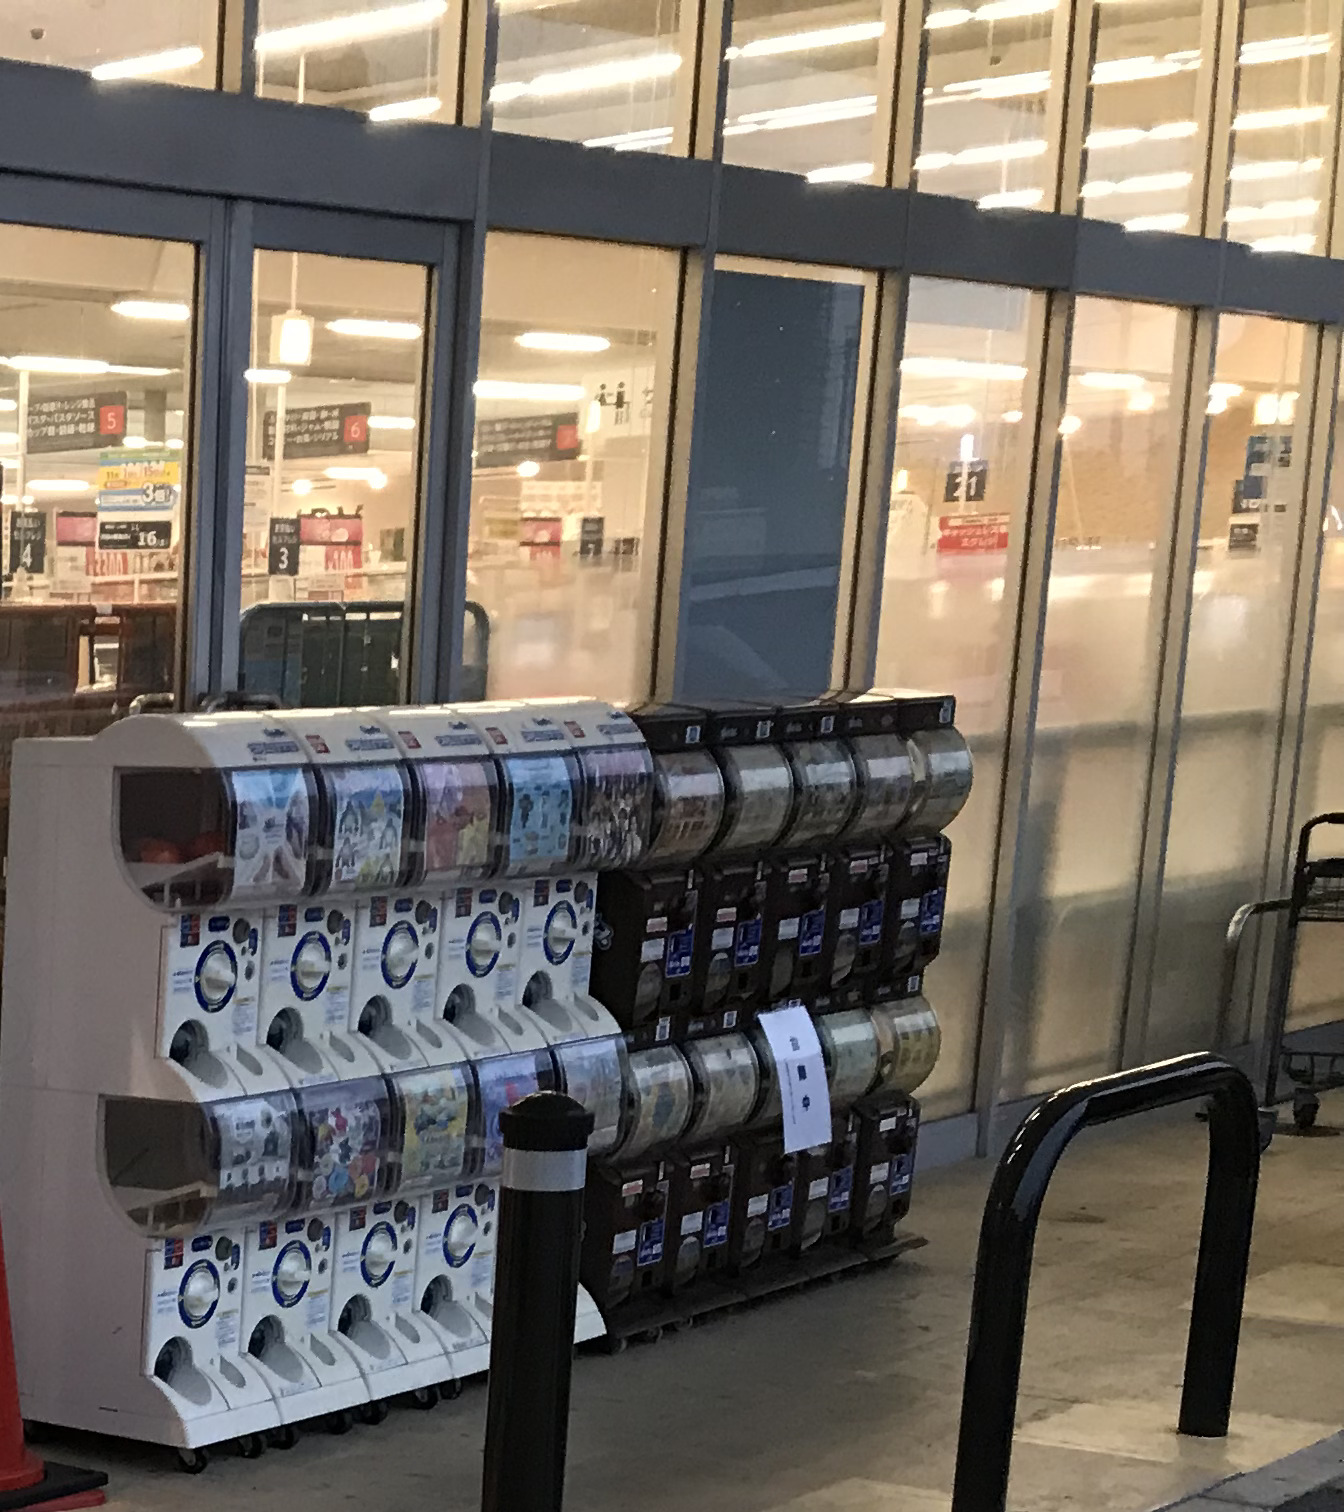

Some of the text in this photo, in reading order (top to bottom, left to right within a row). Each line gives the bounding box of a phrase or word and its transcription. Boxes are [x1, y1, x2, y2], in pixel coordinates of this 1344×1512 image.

[107, 412, 116, 429] 5
[350, 422, 361, 438] 6
[278, 547, 289, 569] 3
